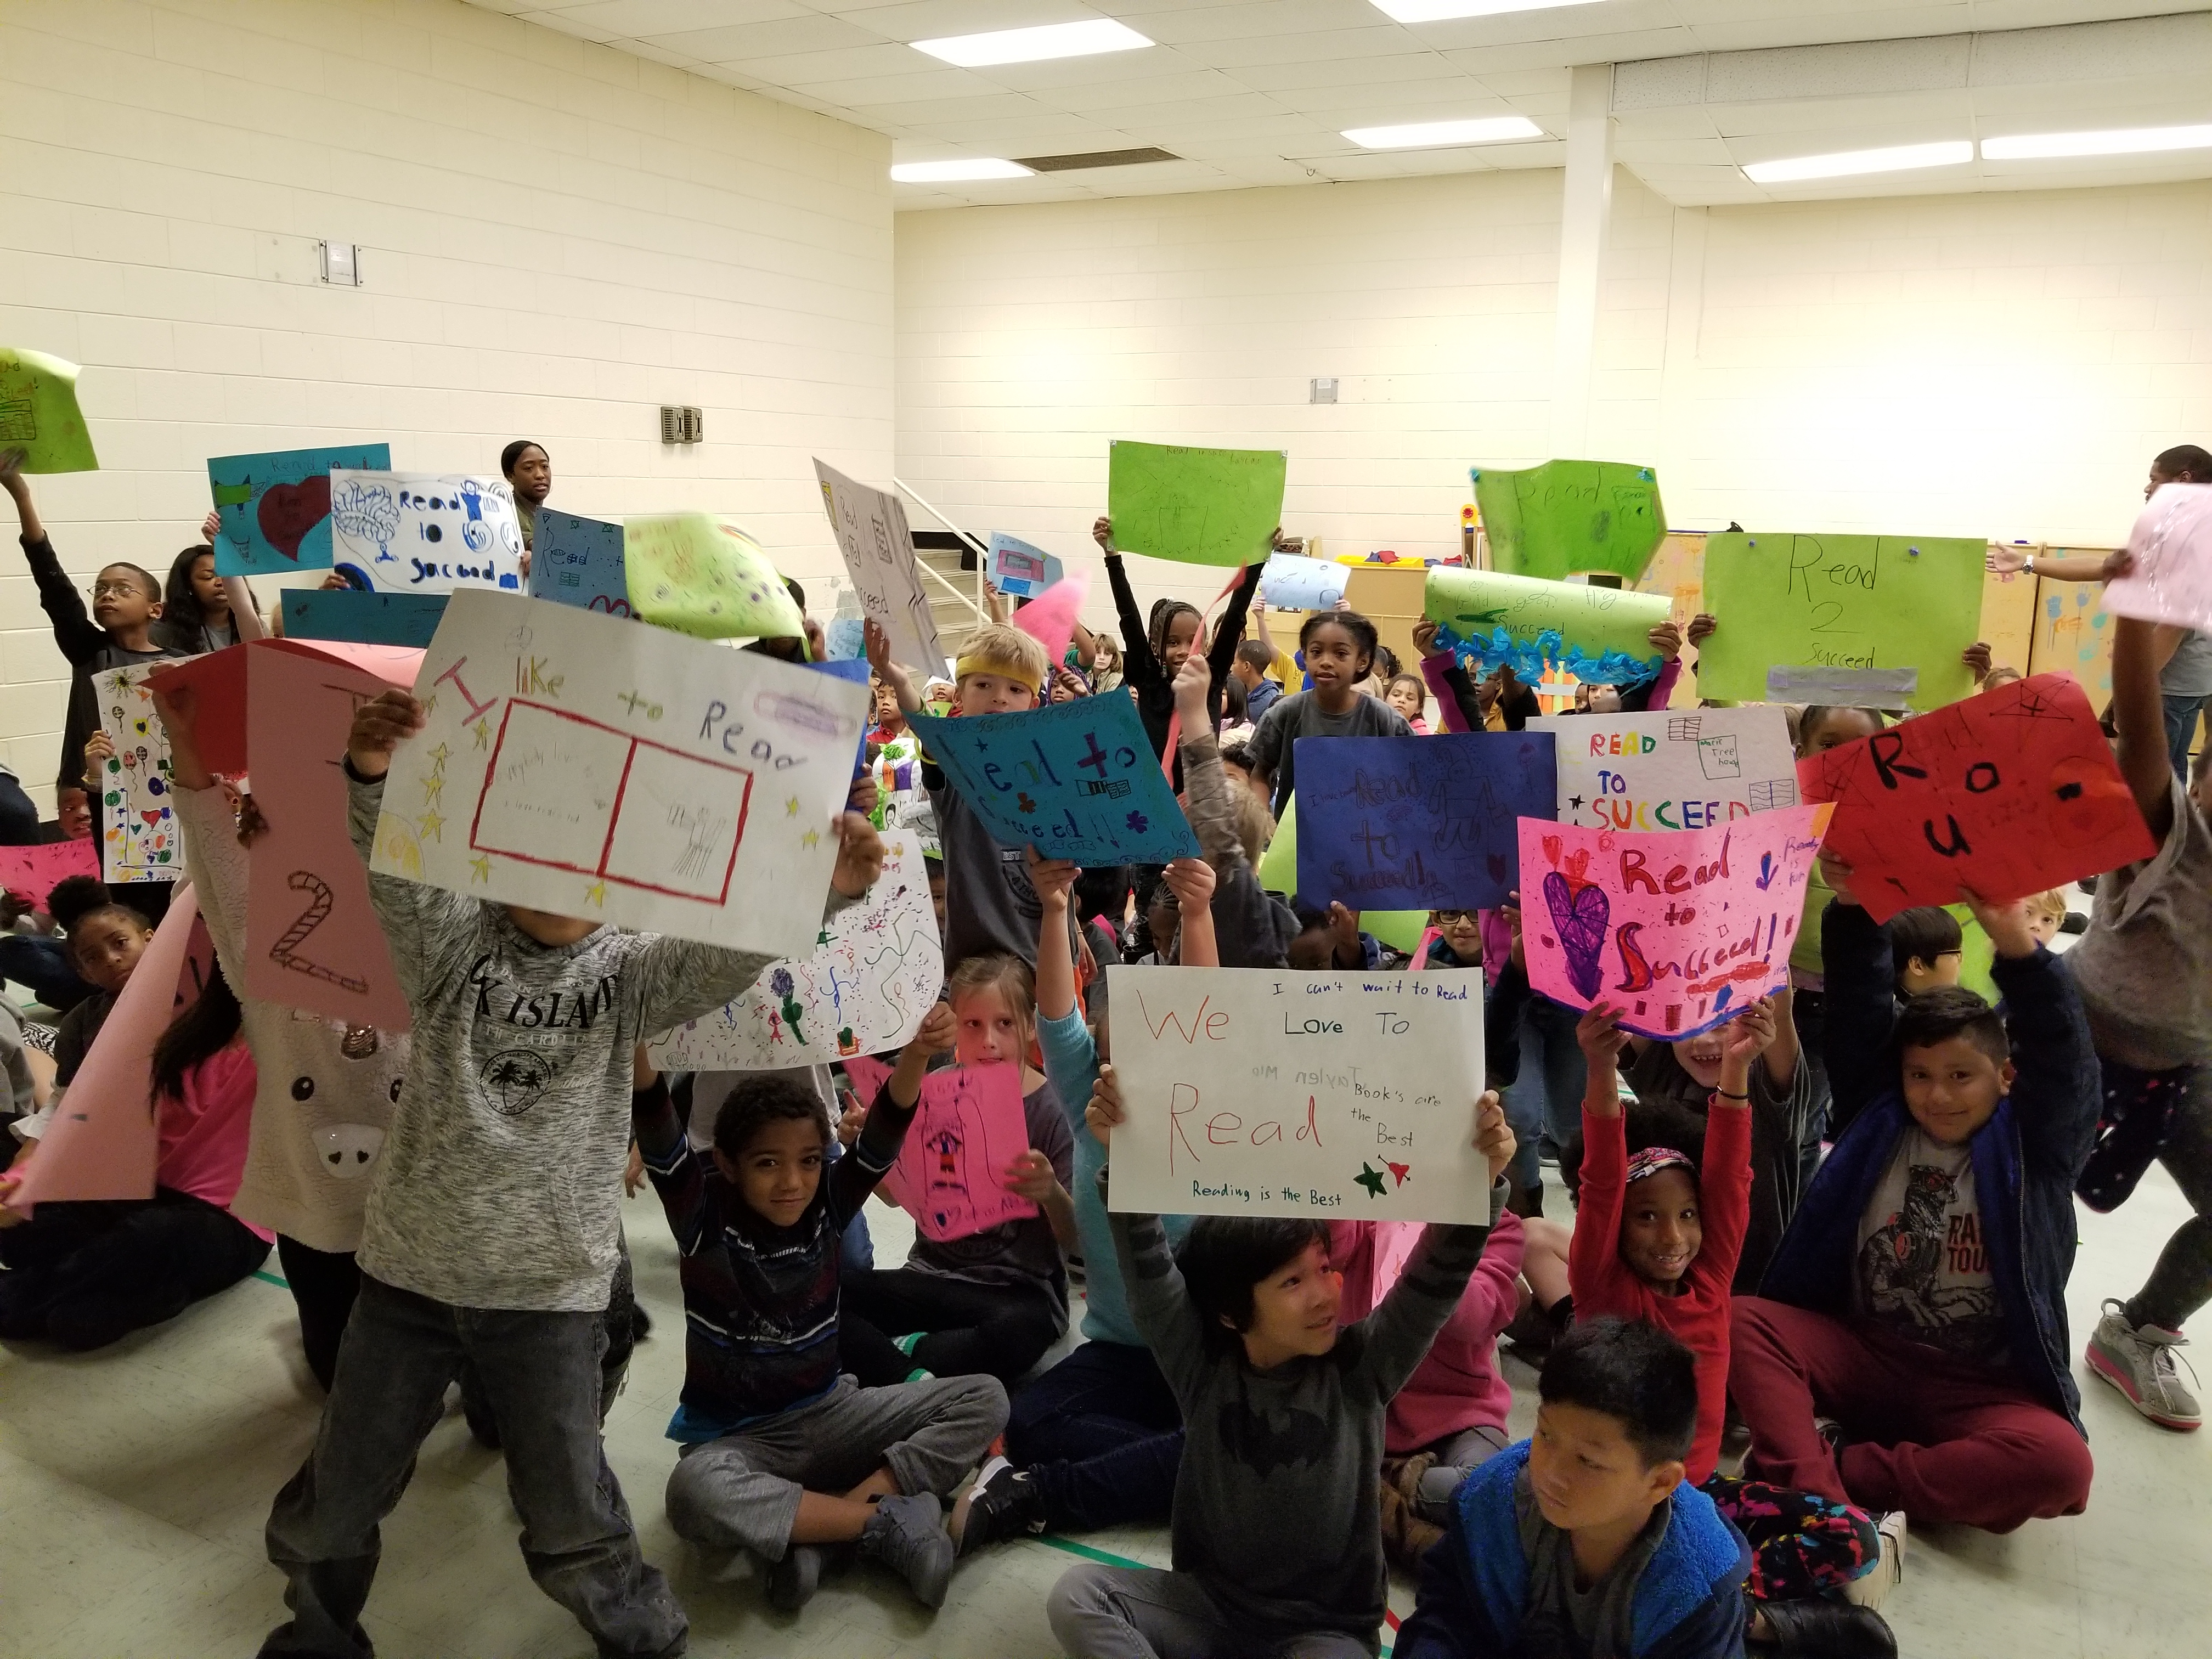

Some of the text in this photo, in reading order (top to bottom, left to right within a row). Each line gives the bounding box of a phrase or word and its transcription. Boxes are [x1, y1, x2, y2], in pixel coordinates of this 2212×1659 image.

[270, 456, 316, 472] Read
[400, 490, 462, 512] Read
[538, 526, 589, 578] Read
[1787, 534, 1881, 603] Read
[1498, 614, 1565, 636] Succeed
[1810, 601, 1865, 634] 2
[433, 656, 498, 726] I
[618, 689, 664, 721] to
[1076, 730, 1137, 779] to
[1590, 731, 1656, 758] READ
[1870, 732, 1927, 789] R
[1355, 761, 1422, 809] Read
[1597, 770, 1627, 794] TO
[1002, 850, 1022, 861] EST
[1350, 820, 1401, 868] to
[1620, 827, 1730, 895] Read
[1664, 902, 1696, 926] to
[269, 870, 370, 994] 2
[1274, 983, 1284, 995] I
[1363, 981, 1402, 994] wait
[1413, 981, 1429, 995] to
[1436, 985, 1468, 1000] Read
[1136, 989, 1409, 1044] We Love To
[1170, 1083, 1322, 1176] Read
[1351, 1108, 1372, 1122] the
[1376, 1122, 1414, 1147] Best
[1193, 1184, 1342, 1206] Reading is the Best
